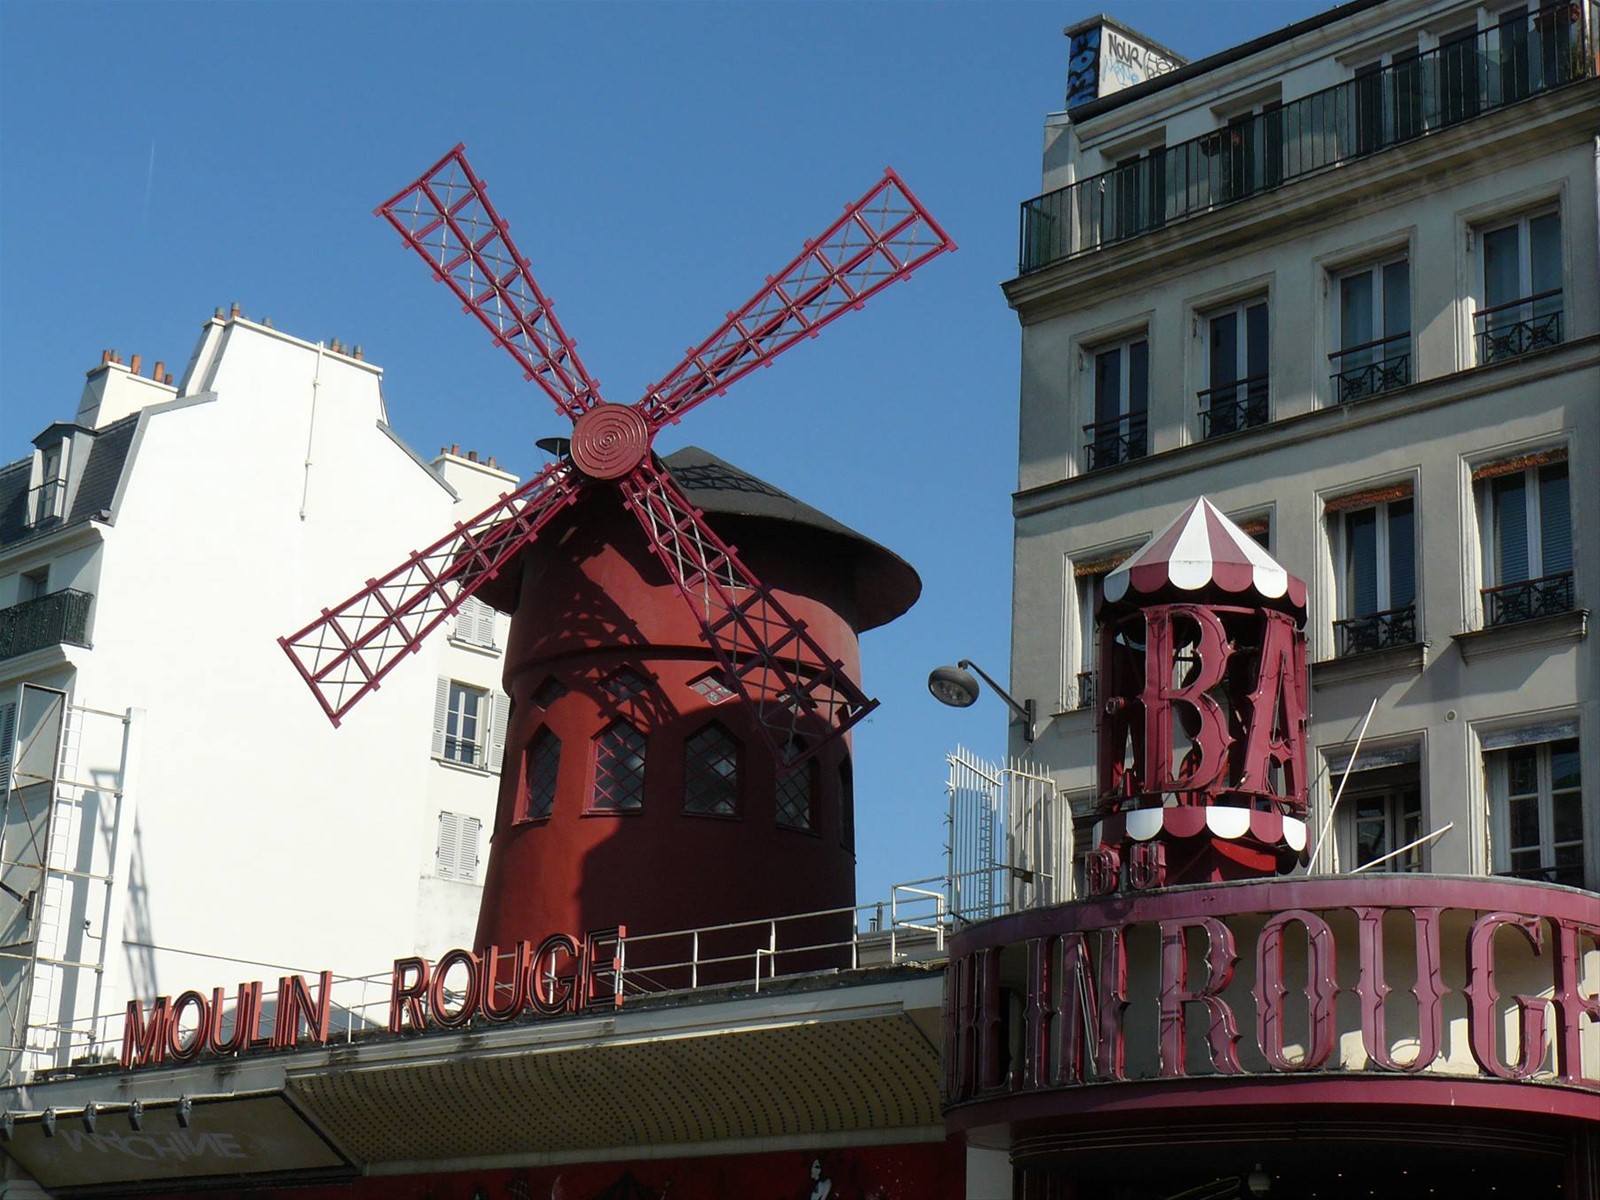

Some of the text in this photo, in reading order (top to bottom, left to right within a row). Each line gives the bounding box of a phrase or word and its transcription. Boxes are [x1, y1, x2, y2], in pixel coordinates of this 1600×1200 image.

[1138, 603, 1307, 806] BA
[1085, 841, 1166, 896] DU
[121, 925, 625, 1067] MOULIN ROUGE
